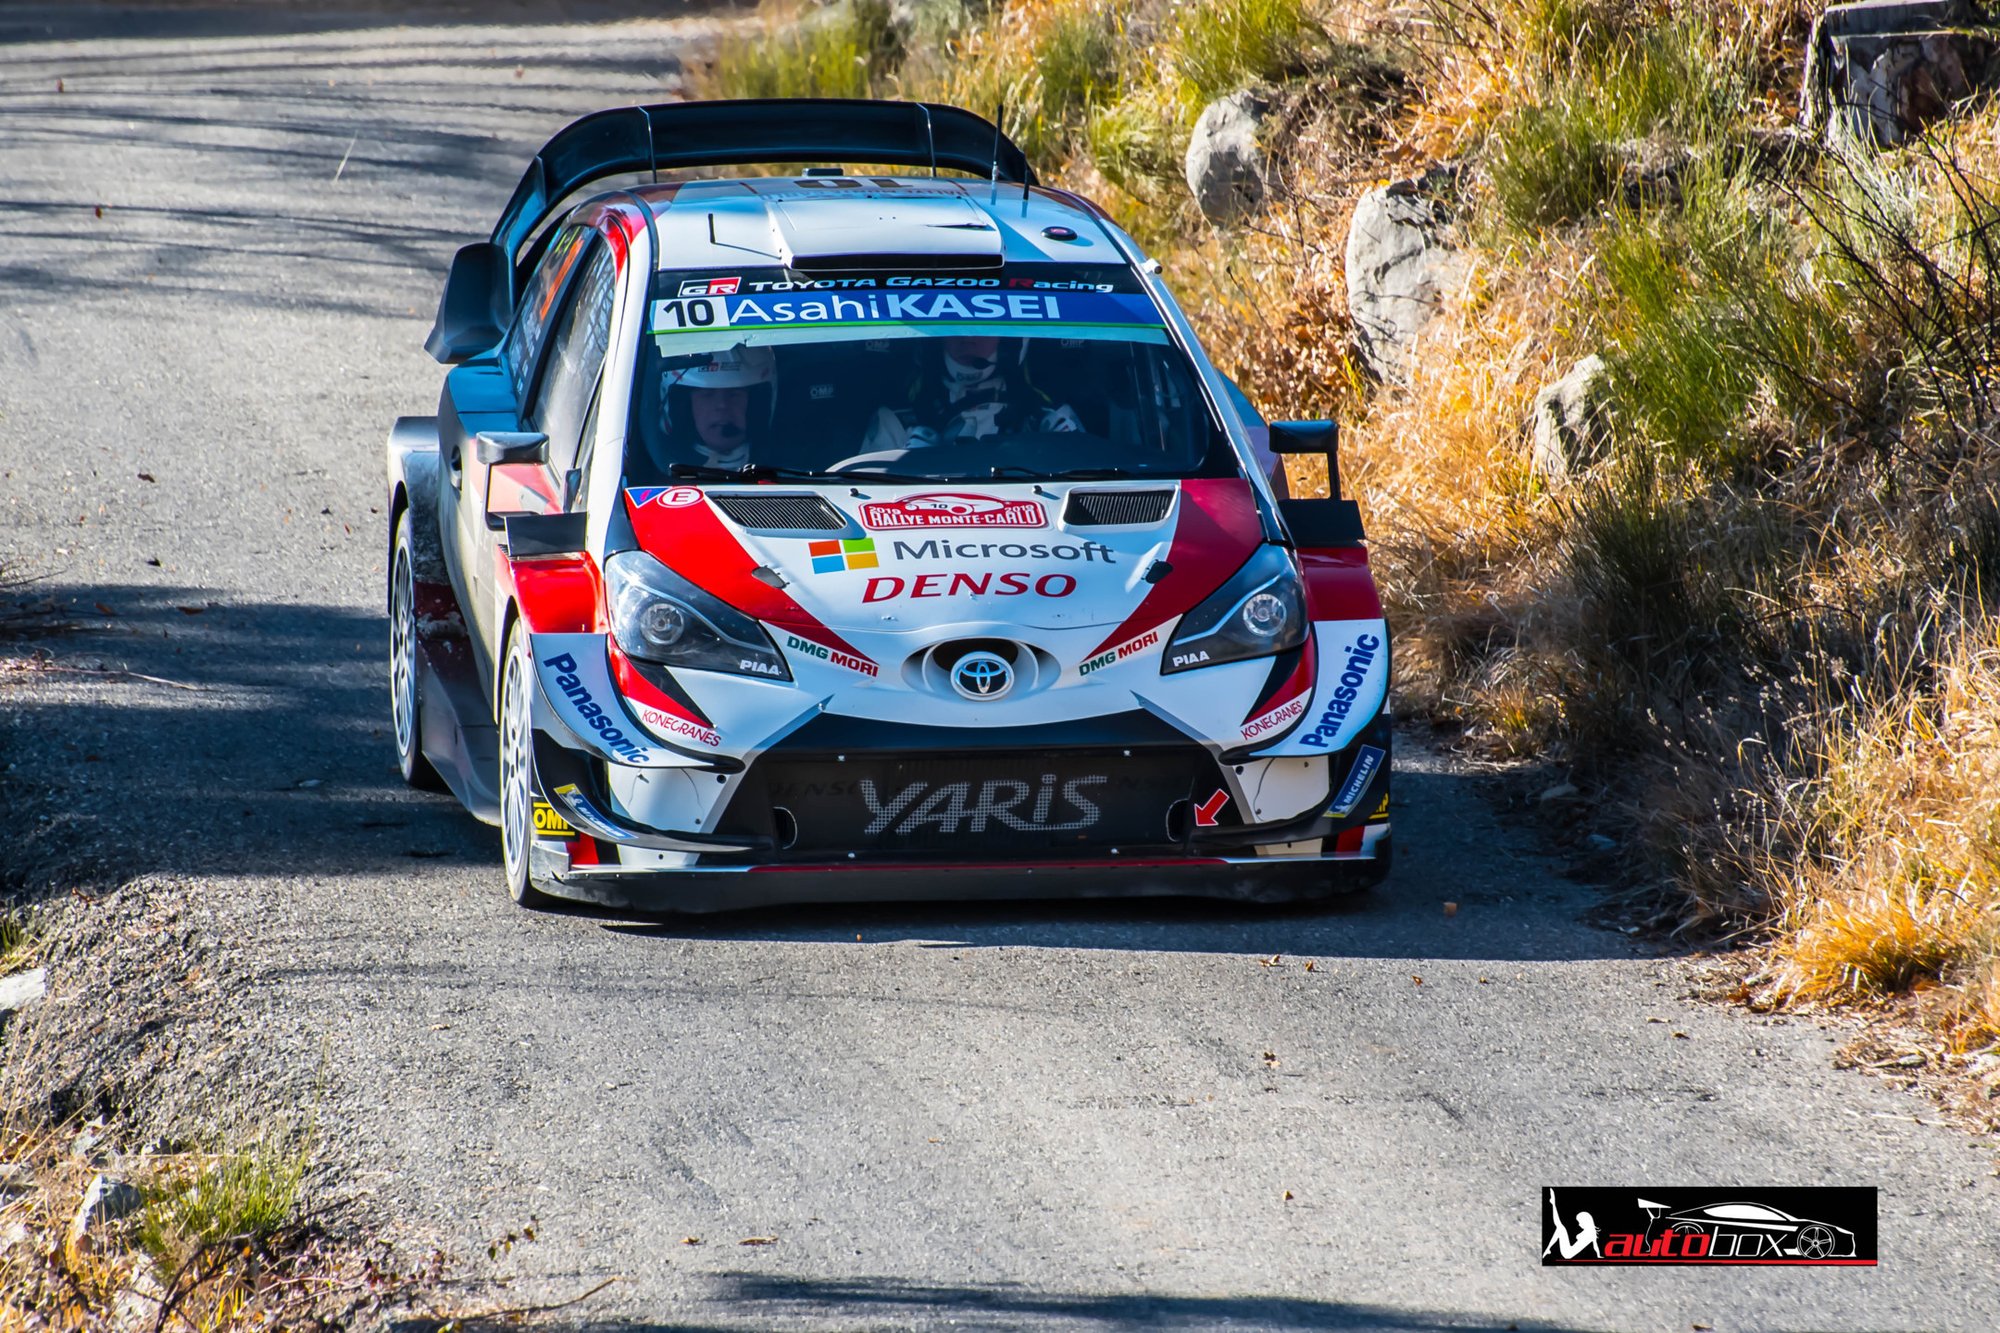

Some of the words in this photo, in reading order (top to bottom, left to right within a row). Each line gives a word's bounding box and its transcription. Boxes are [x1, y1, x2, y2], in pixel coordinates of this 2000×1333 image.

[681, 284, 737, 295] GR
[749, 279, 876, 291] TOYOTA
[886, 276, 1000, 287] GAZOO
[1008, 278, 1114, 293] Racing
[663, 299, 715, 327] 10
[671, 492, 691, 502] E
[871, 511, 925, 526] RALLYE
[929, 509, 1038, 525] MONTE-CARLO
[893, 540, 1116, 564] Microsoft
[862, 573, 1076, 603] DENSO
[740, 659, 780, 676] PIAA
[787, 635, 829, 659] DMG
[830, 651, 878, 677] MORI
[1079, 652, 1116, 676] DMG
[1117, 631, 1158, 659] MORI
[1172, 650, 1210, 667] PIAA
[1299, 633, 1380, 748] Panasonic
[543, 652, 650, 763] Panasonic
[1240, 700, 1303, 740] KONECRANES
[642, 709, 722, 747] KONECRANES
[1343, 754, 1374, 804] MICHELIN
